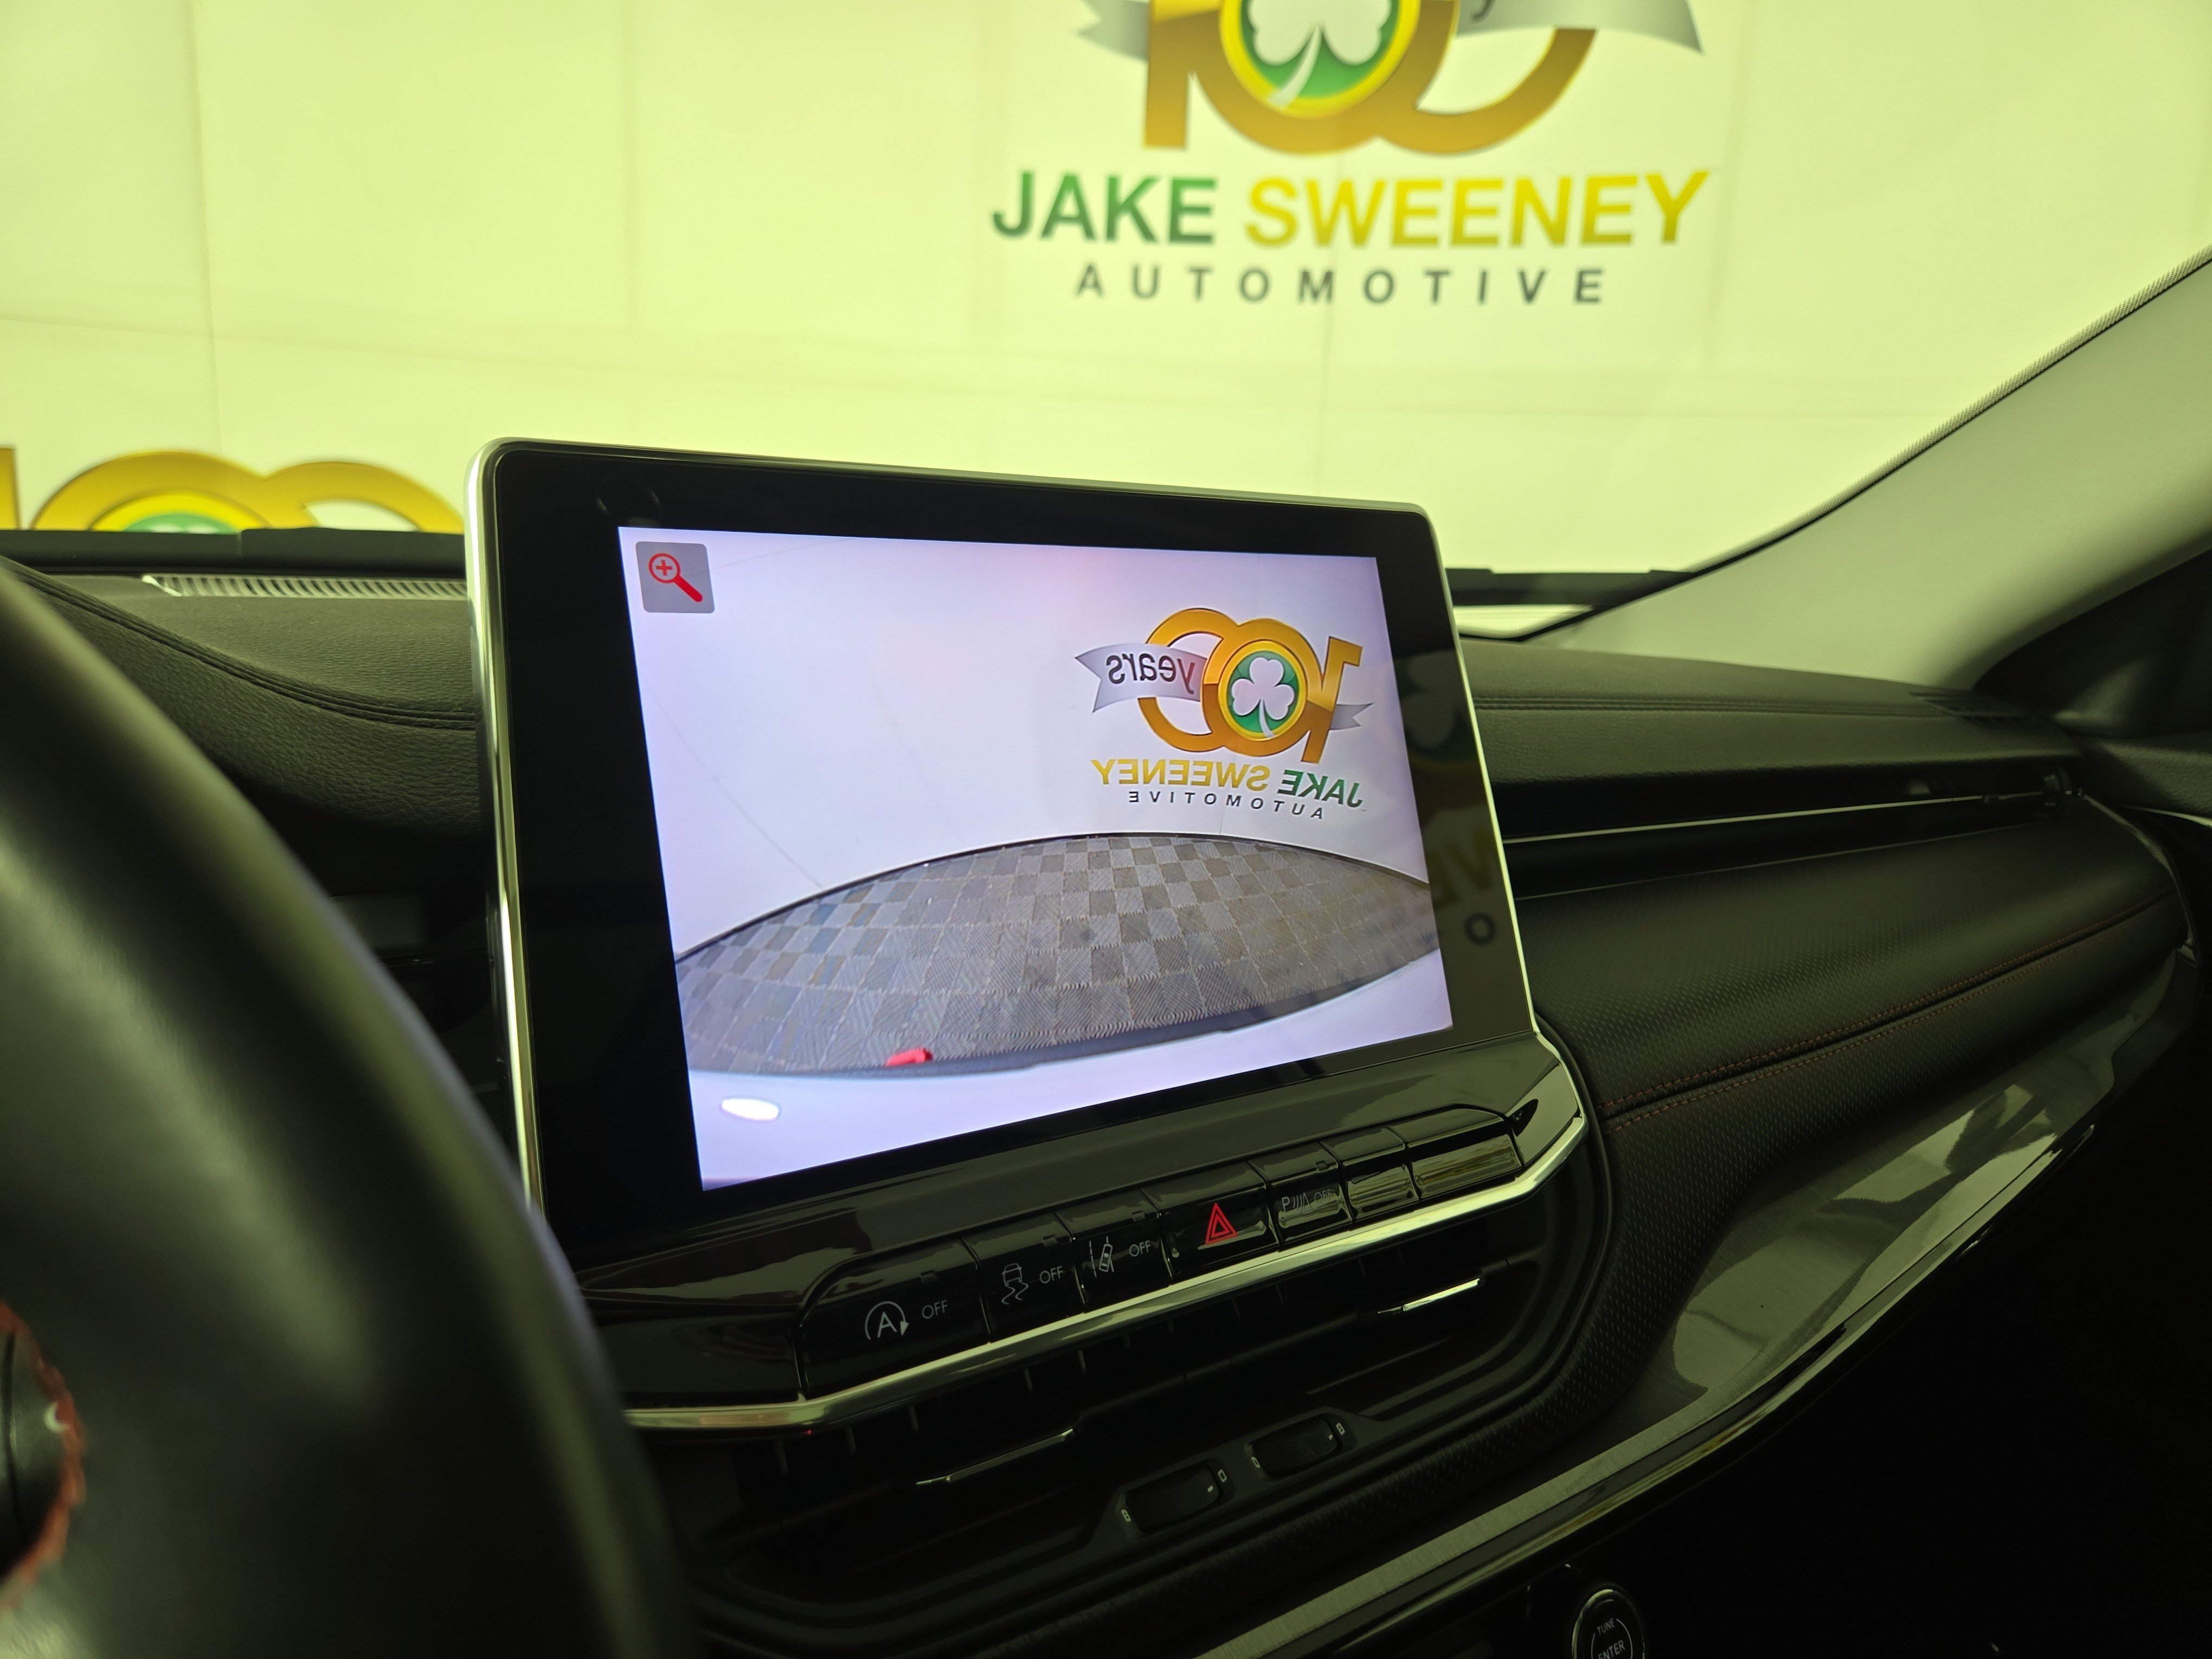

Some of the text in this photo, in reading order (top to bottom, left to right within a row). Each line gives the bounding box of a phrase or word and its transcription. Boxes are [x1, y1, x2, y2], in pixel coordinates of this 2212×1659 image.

[991, 170, 1709, 249] JAKE SWEENEY
[1075, 264, 1604, 305] AUTOMOTIVE
[1129, 1240, 1151, 1257] OFF
[1039, 1266, 1064, 1284] OFF
[922, 1300, 948, 1320] OFF
[1597, 1618, 1615, 1636] TUNE
